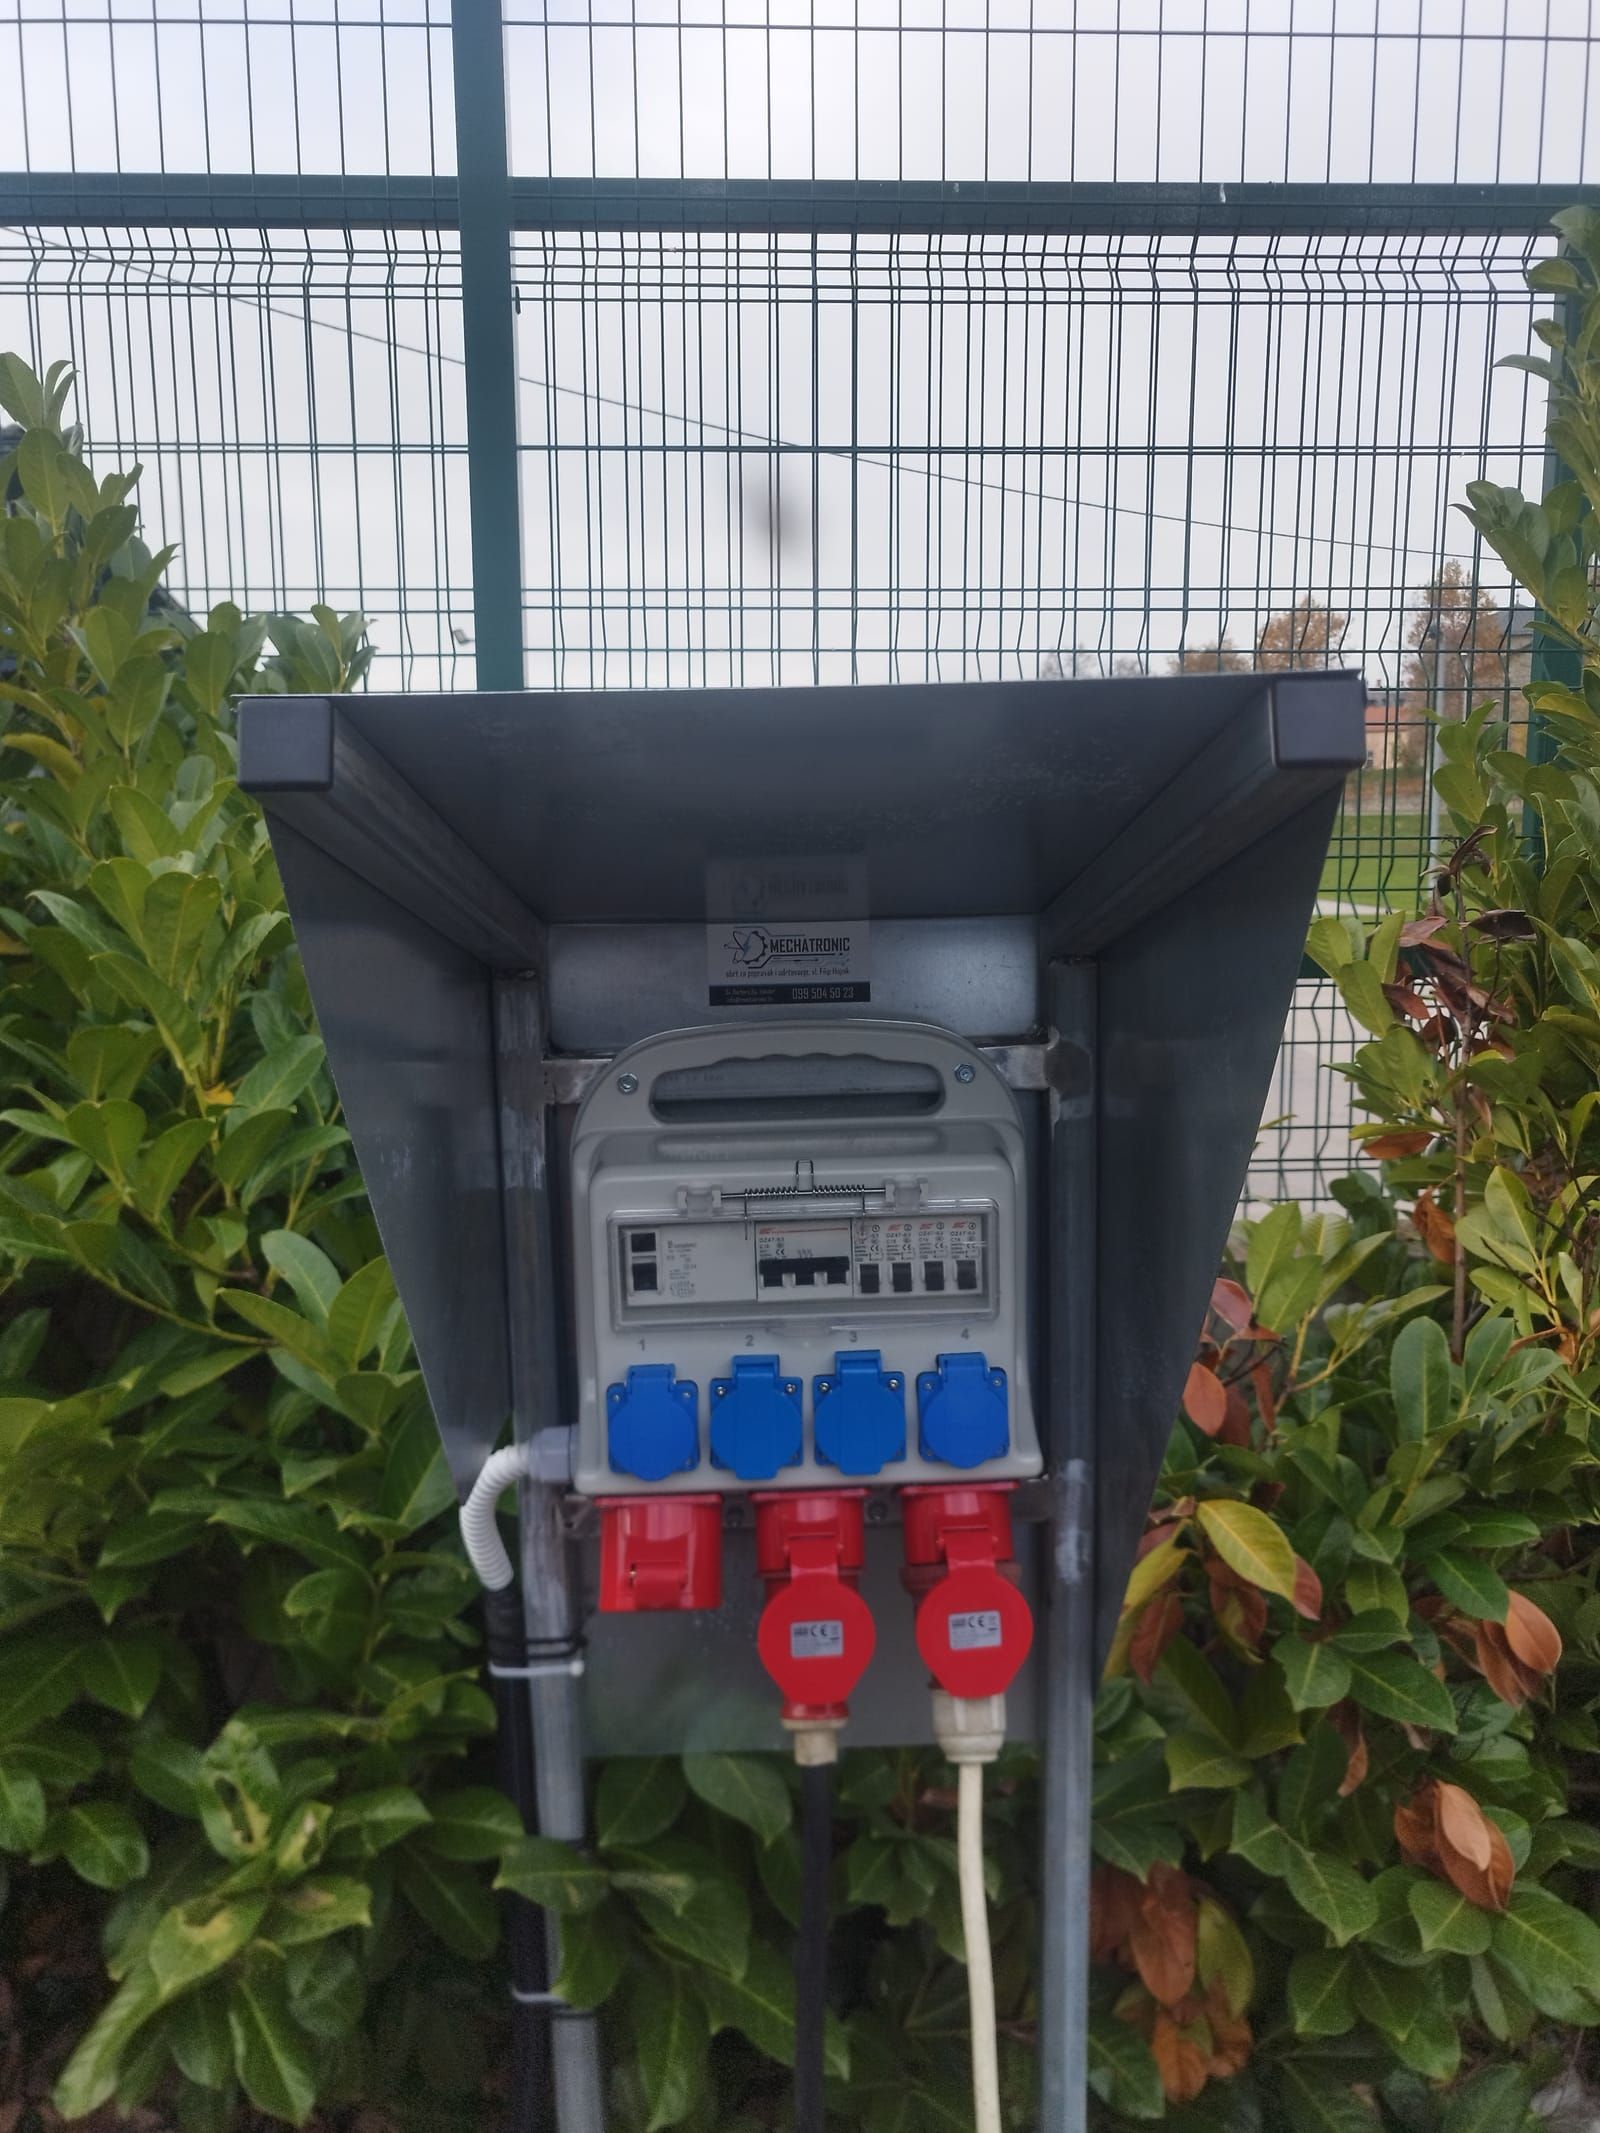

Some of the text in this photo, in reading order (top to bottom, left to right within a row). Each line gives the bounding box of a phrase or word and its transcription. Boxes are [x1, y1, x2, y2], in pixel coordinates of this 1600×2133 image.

[770, 937, 850, 953] MECHATRONIC
[811, 987, 827, 999] 504
[829, 986, 841, 999] 50
[843, 986, 854, 998] 23
[745, 1334, 754, 1347] 2
[850, 1330, 858, 1343] 3
[960, 1328, 969, 1340] 4
[638, 1339, 646, 1351] 1
[967, 1615, 985, 1628] CE
[810, 1624, 828, 1637] CE
